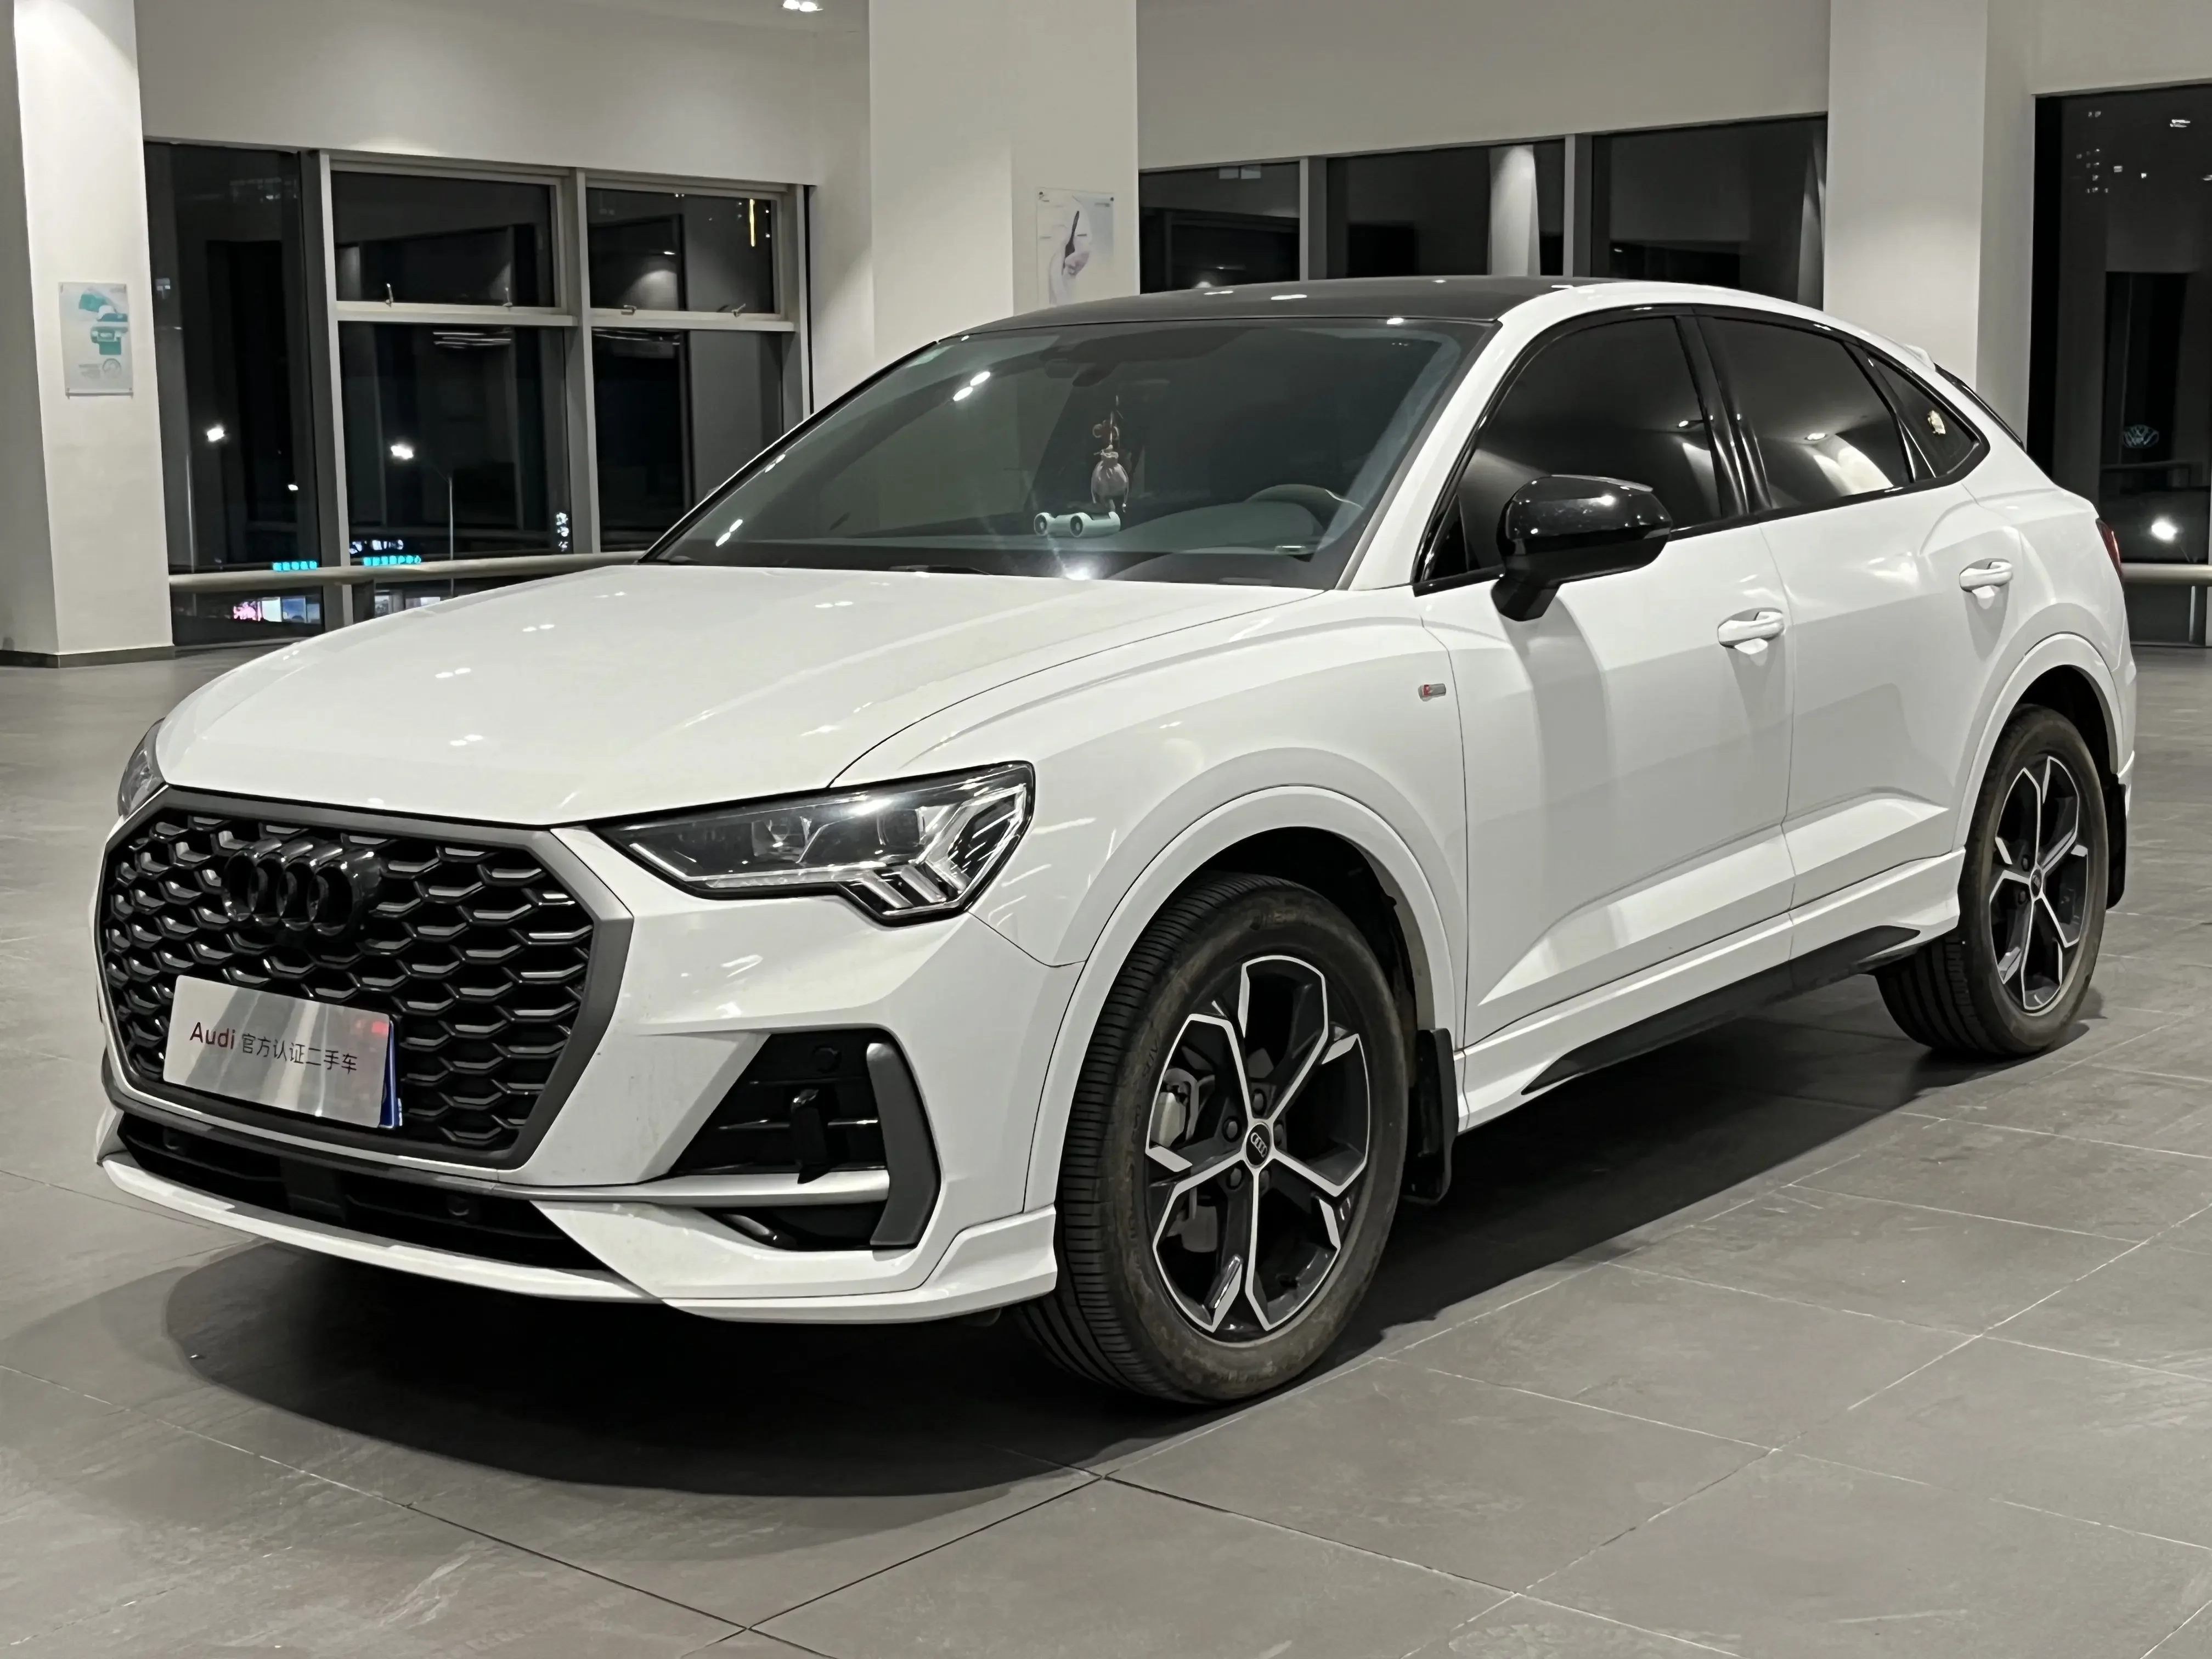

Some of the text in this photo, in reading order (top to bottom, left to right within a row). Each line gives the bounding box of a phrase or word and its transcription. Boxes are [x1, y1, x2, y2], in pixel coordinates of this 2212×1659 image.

[189, 1021, 358, 1074] Audi 官方认证二手车
